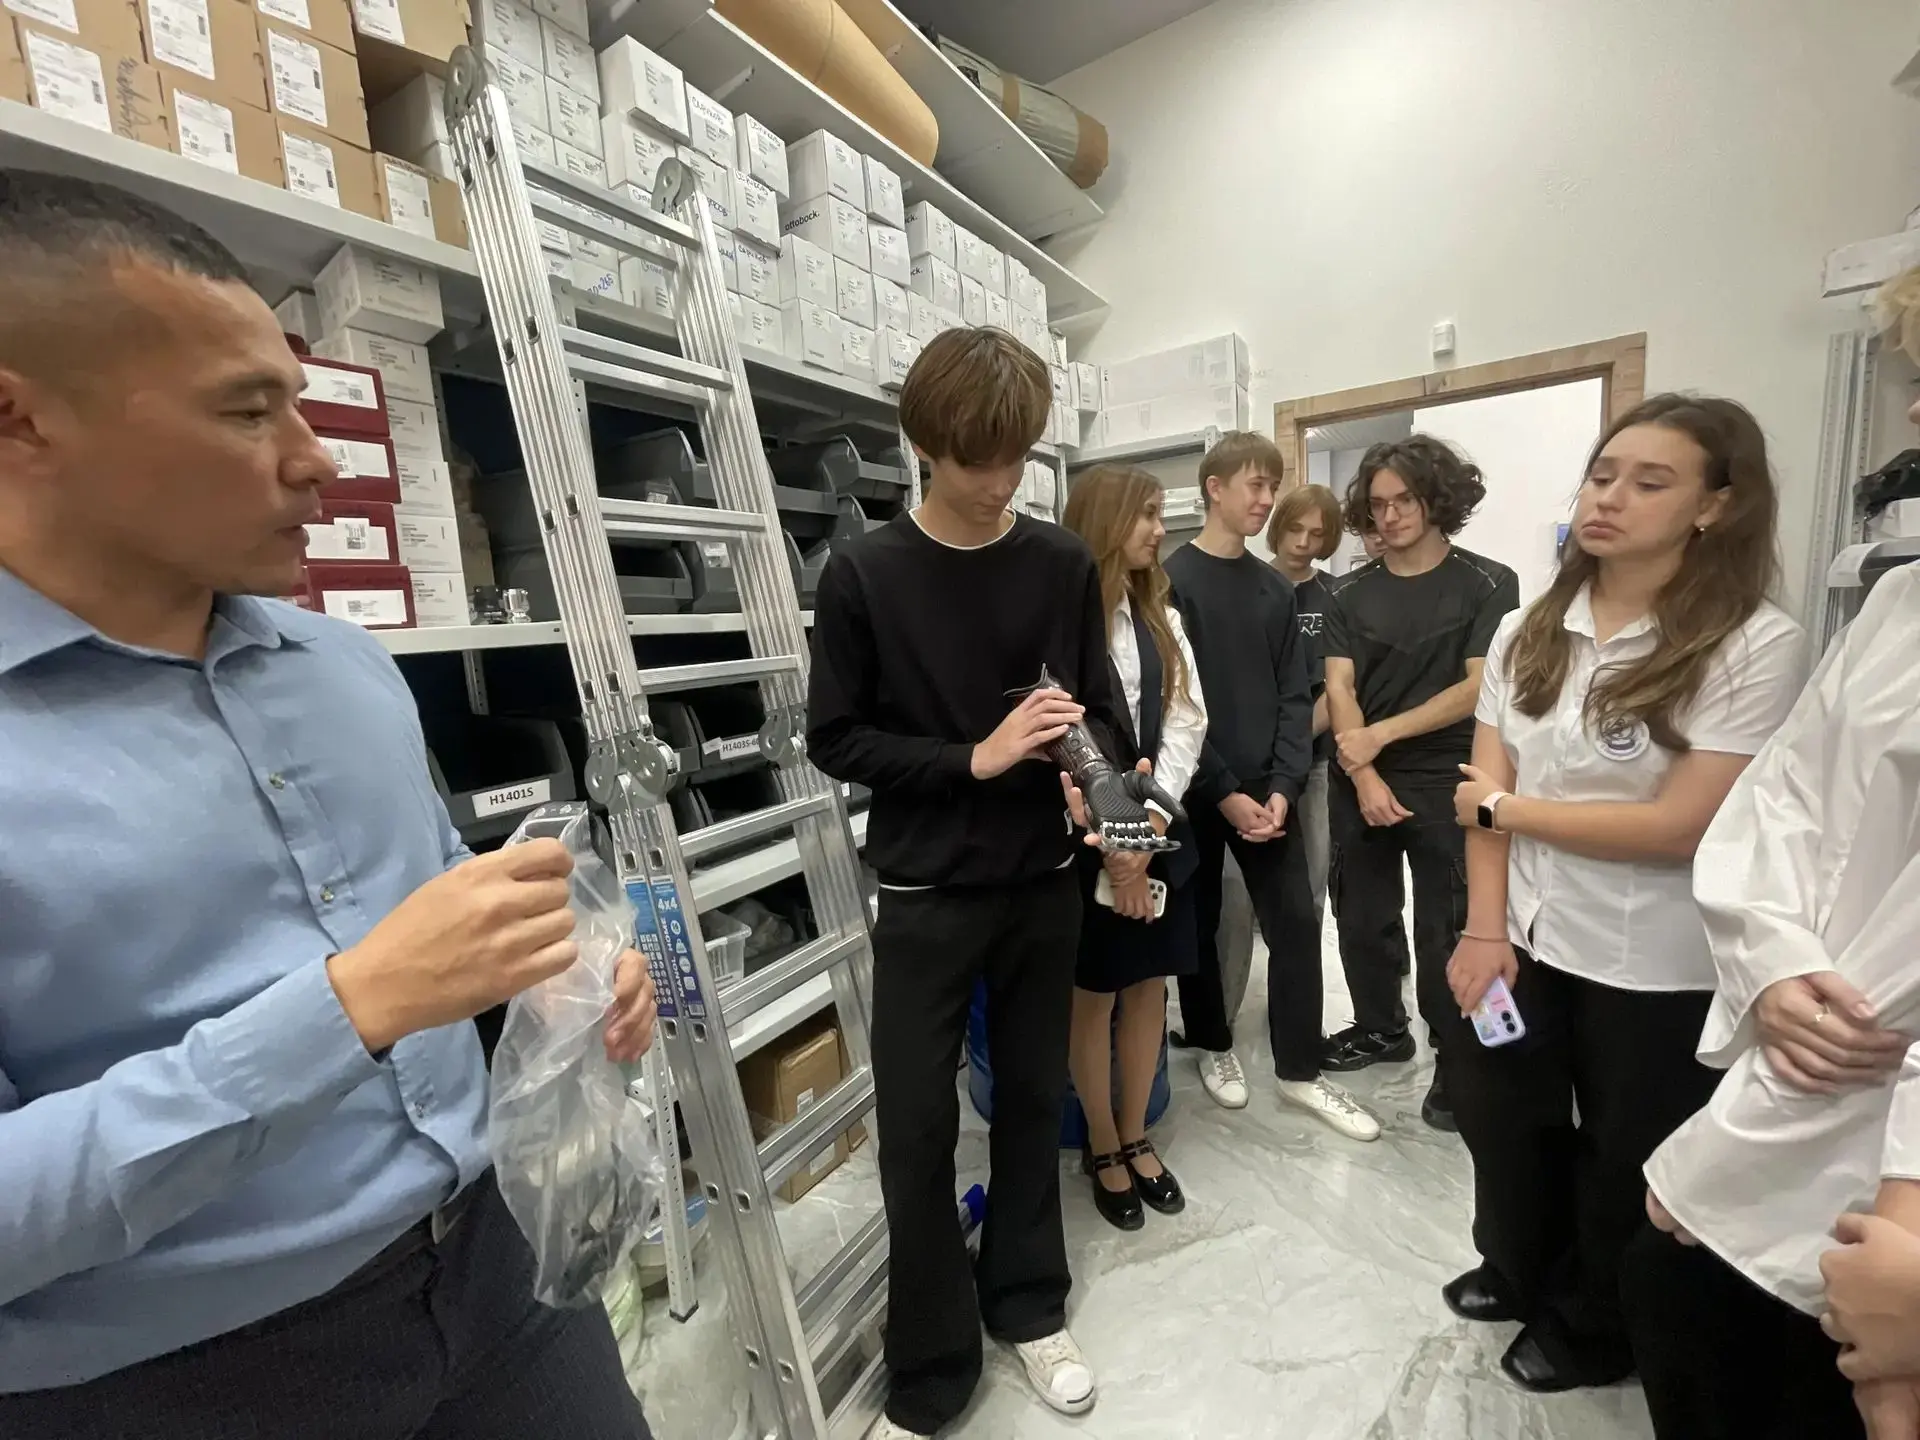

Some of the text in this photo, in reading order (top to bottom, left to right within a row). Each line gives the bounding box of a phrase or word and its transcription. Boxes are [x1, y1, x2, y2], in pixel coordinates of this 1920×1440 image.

[784, 210, 820, 231] ottobock.
[489, 786, 534, 806] H1401S
[657, 898, 678, 911] 4x4
[660, 917, 685, 998] MANOL HOME
